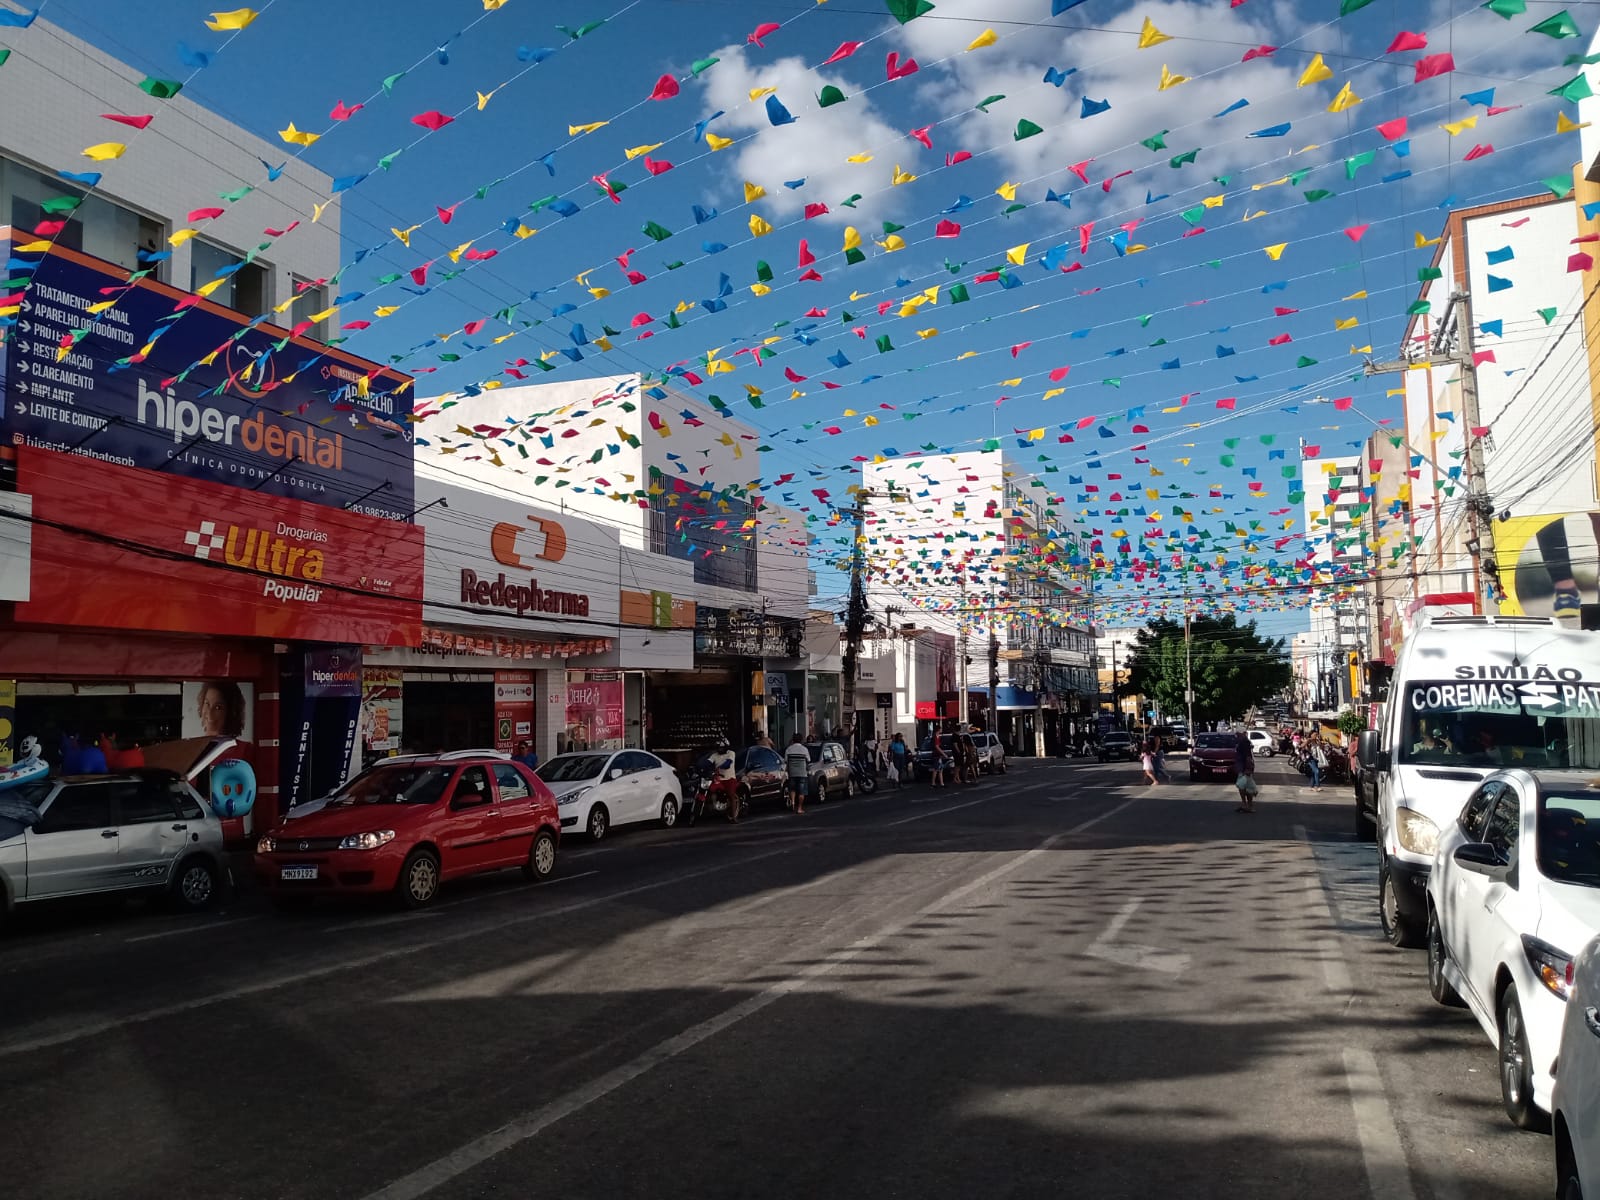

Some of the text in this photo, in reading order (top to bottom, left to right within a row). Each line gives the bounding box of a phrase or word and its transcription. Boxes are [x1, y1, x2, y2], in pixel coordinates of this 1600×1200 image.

[35, 303, 79, 328] APARELHO
[104, 308, 130, 326] CANAL
[31, 362, 94, 391] CLAREAMENTO
[31, 382, 76, 406] IMPLANTE
[30, 402, 108, 433] LENTE DE CONTATO
[277, 521, 328, 543] Drogarias
[223, 525, 325, 581] Ultra
[263, 579, 323, 604] Popular
[460, 567, 589, 618] Redepharma
[311, 669, 360, 684] hiperdental
[1454, 663, 1583, 683] SIMIÃO
[1412, 683, 1517, 710] COREMAS
